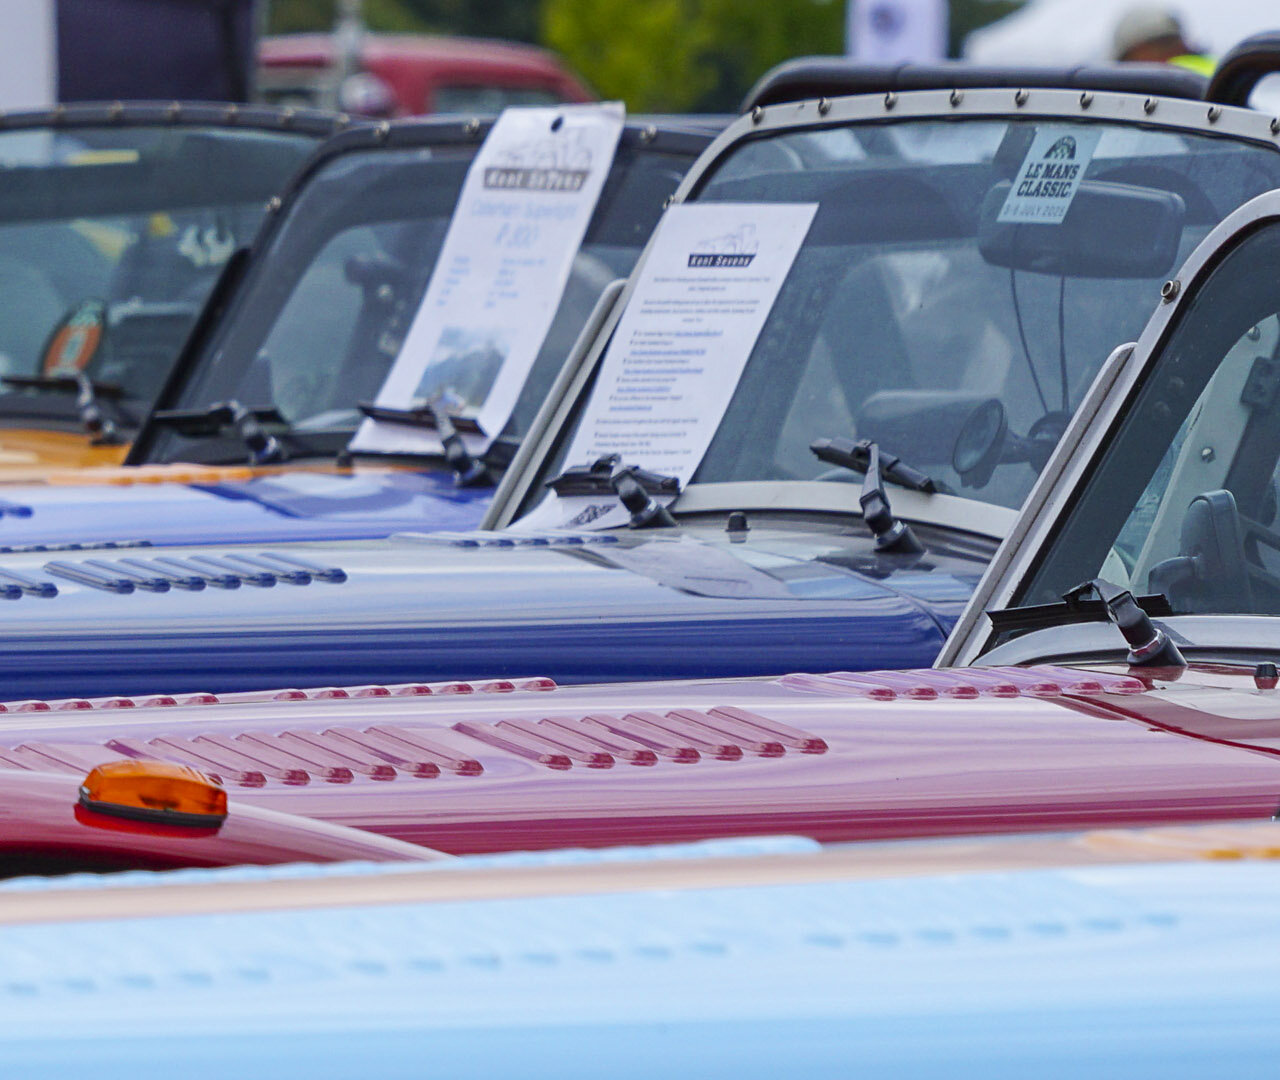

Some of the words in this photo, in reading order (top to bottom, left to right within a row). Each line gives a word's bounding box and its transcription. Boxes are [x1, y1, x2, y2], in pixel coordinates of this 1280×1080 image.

[1025, 163, 1043, 178] LE
[1041, 163, 1080, 180] MANS
[1016, 180, 1072, 198] CLASSIC
[691, 255, 715, 266] Kent
[716, 255, 751, 267] Sevens
